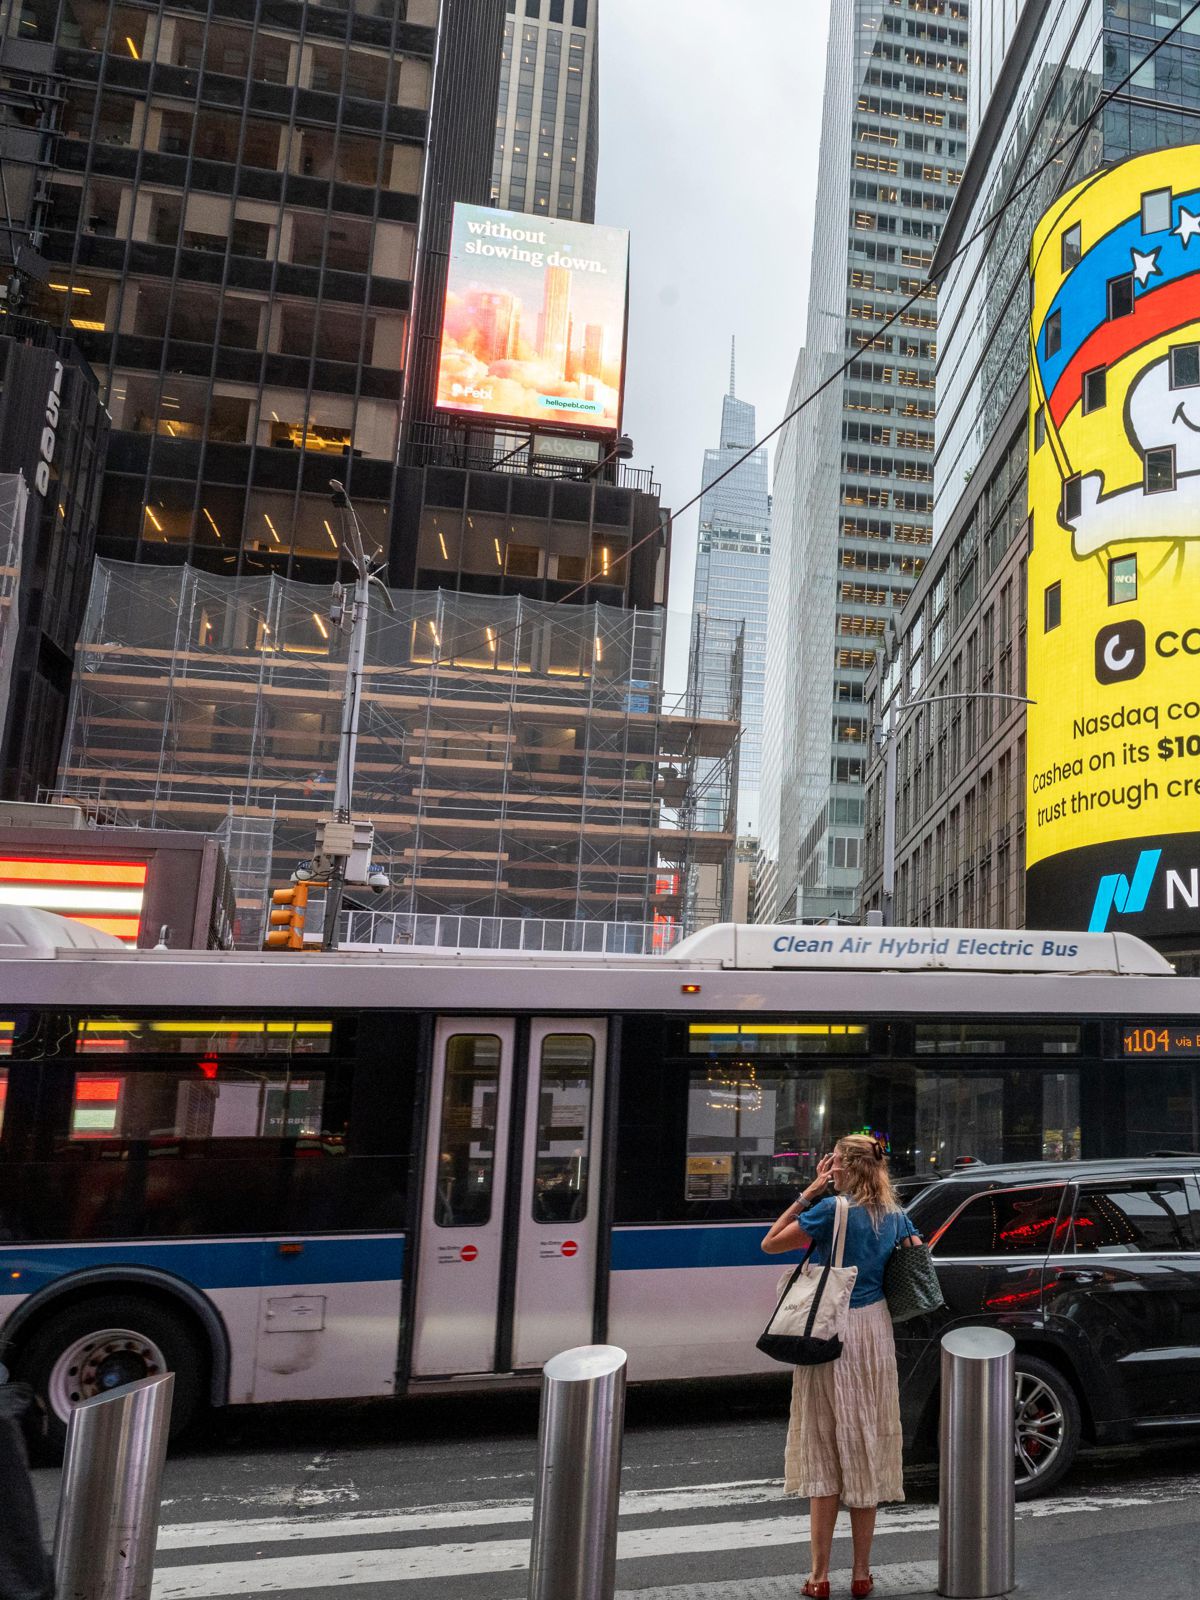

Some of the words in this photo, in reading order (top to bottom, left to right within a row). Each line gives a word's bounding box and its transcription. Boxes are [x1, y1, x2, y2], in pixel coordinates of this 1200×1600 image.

[467, 220, 546, 245] without
[465, 239, 543, 268] slowing
[547, 250, 608, 274] down.
[464, 386, 493, 400] Pebl
[546, 398, 596, 411] hellopebl.com
[35, 360, 64, 496] 1500
[1073, 704, 1160, 740] Nasdaq
[1032, 755, 1083, 794] Cashea
[1089, 749, 1116, 772] on
[1122, 742, 1150, 766] its
[1037, 798, 1067, 828] trust
[1071, 778, 1158, 816] through
[772, 936, 834, 954] Clean
[840, 936, 872, 954] Air
[879, 938, 950, 958] Hybrid
[956, 938, 1033, 956] Electric
[1041, 940, 1078, 958] Bus
[1124, 1029, 1170, 1052] M104
[1175, 1036, 1192, 1047] via
